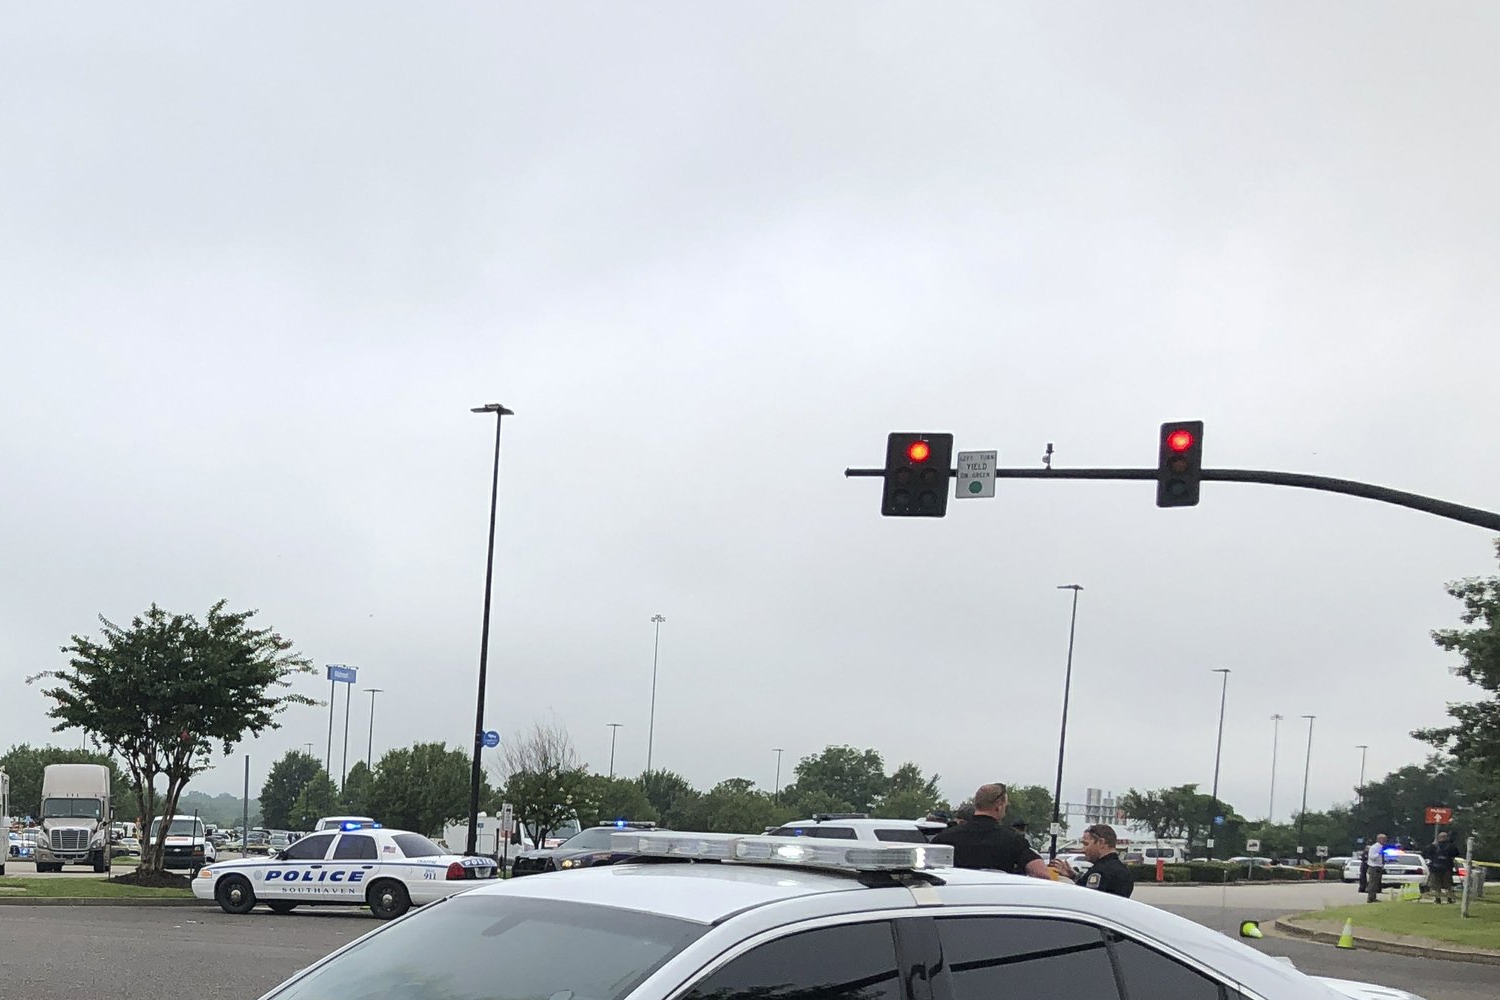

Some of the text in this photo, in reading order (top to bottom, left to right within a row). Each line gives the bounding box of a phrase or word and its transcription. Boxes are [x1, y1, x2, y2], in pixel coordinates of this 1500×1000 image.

[966, 462, 988, 471] YIELD
[264, 870, 366, 882] POLICE
[423, 872, 437, 880] 911
